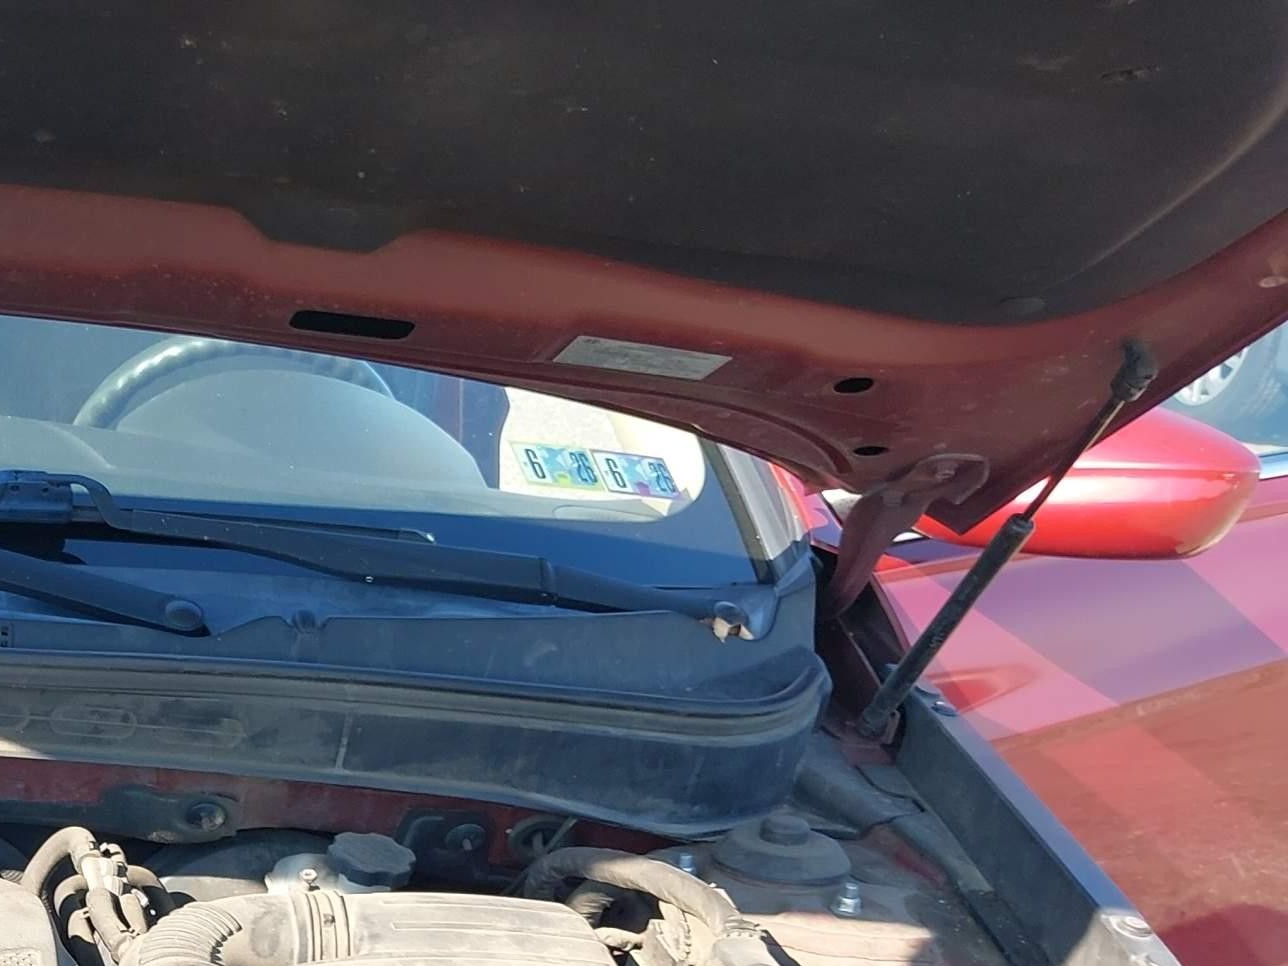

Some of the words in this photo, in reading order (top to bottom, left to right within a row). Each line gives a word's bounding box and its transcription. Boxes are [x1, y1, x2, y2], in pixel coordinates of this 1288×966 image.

[524, 448, 546, 479] 6
[569, 451, 598, 484] 26
[605, 457, 627, 488] 6
